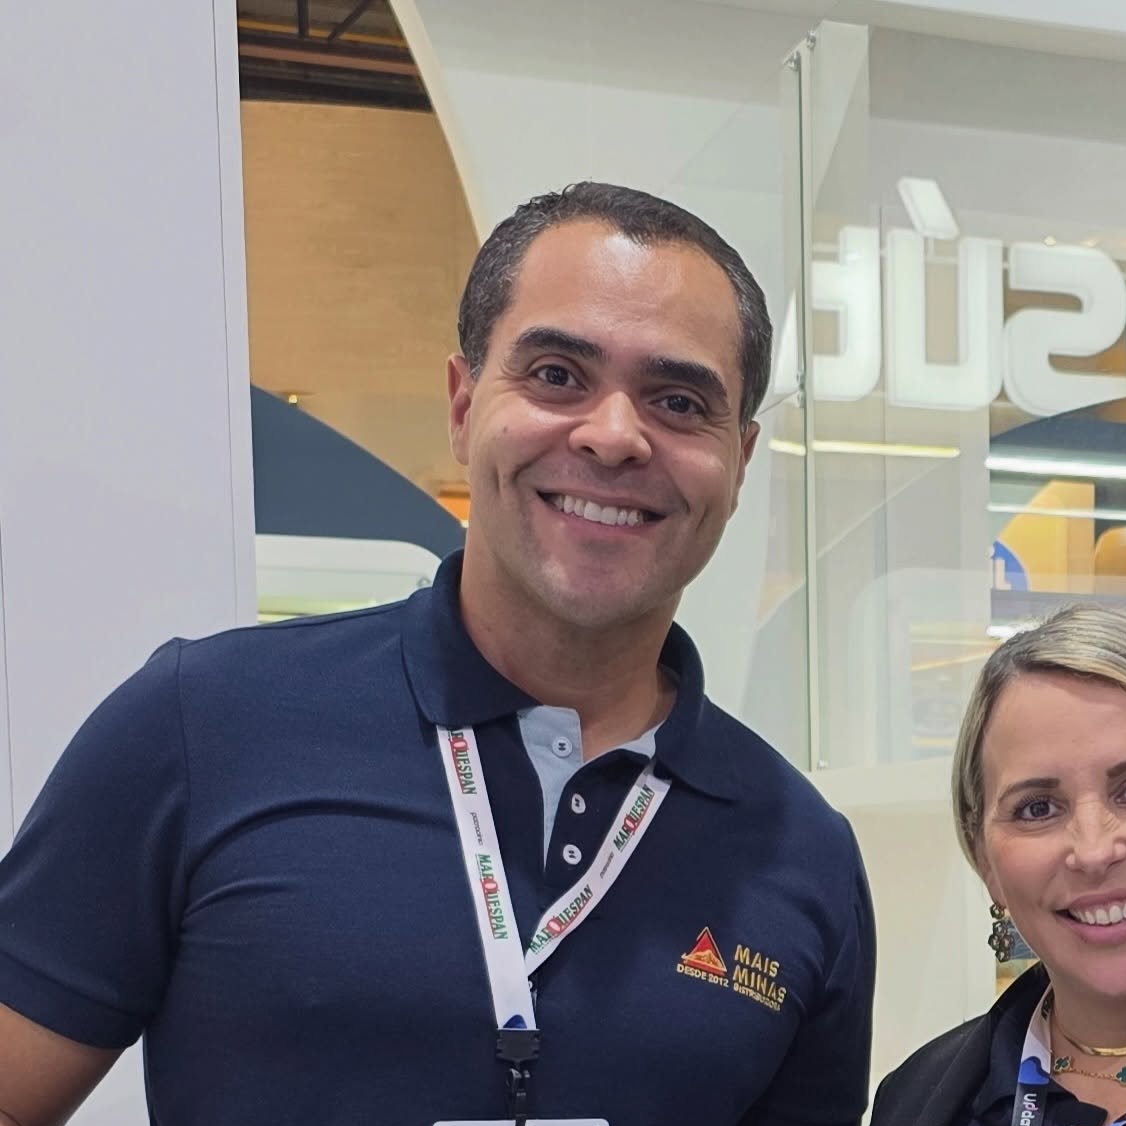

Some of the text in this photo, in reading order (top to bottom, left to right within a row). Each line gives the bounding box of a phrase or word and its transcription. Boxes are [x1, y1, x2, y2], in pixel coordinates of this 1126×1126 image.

[676, 963, 729, 988] DESDE 2012
[734, 944, 780, 977] MAIS
[732, 965, 787, 1004] MINAS
